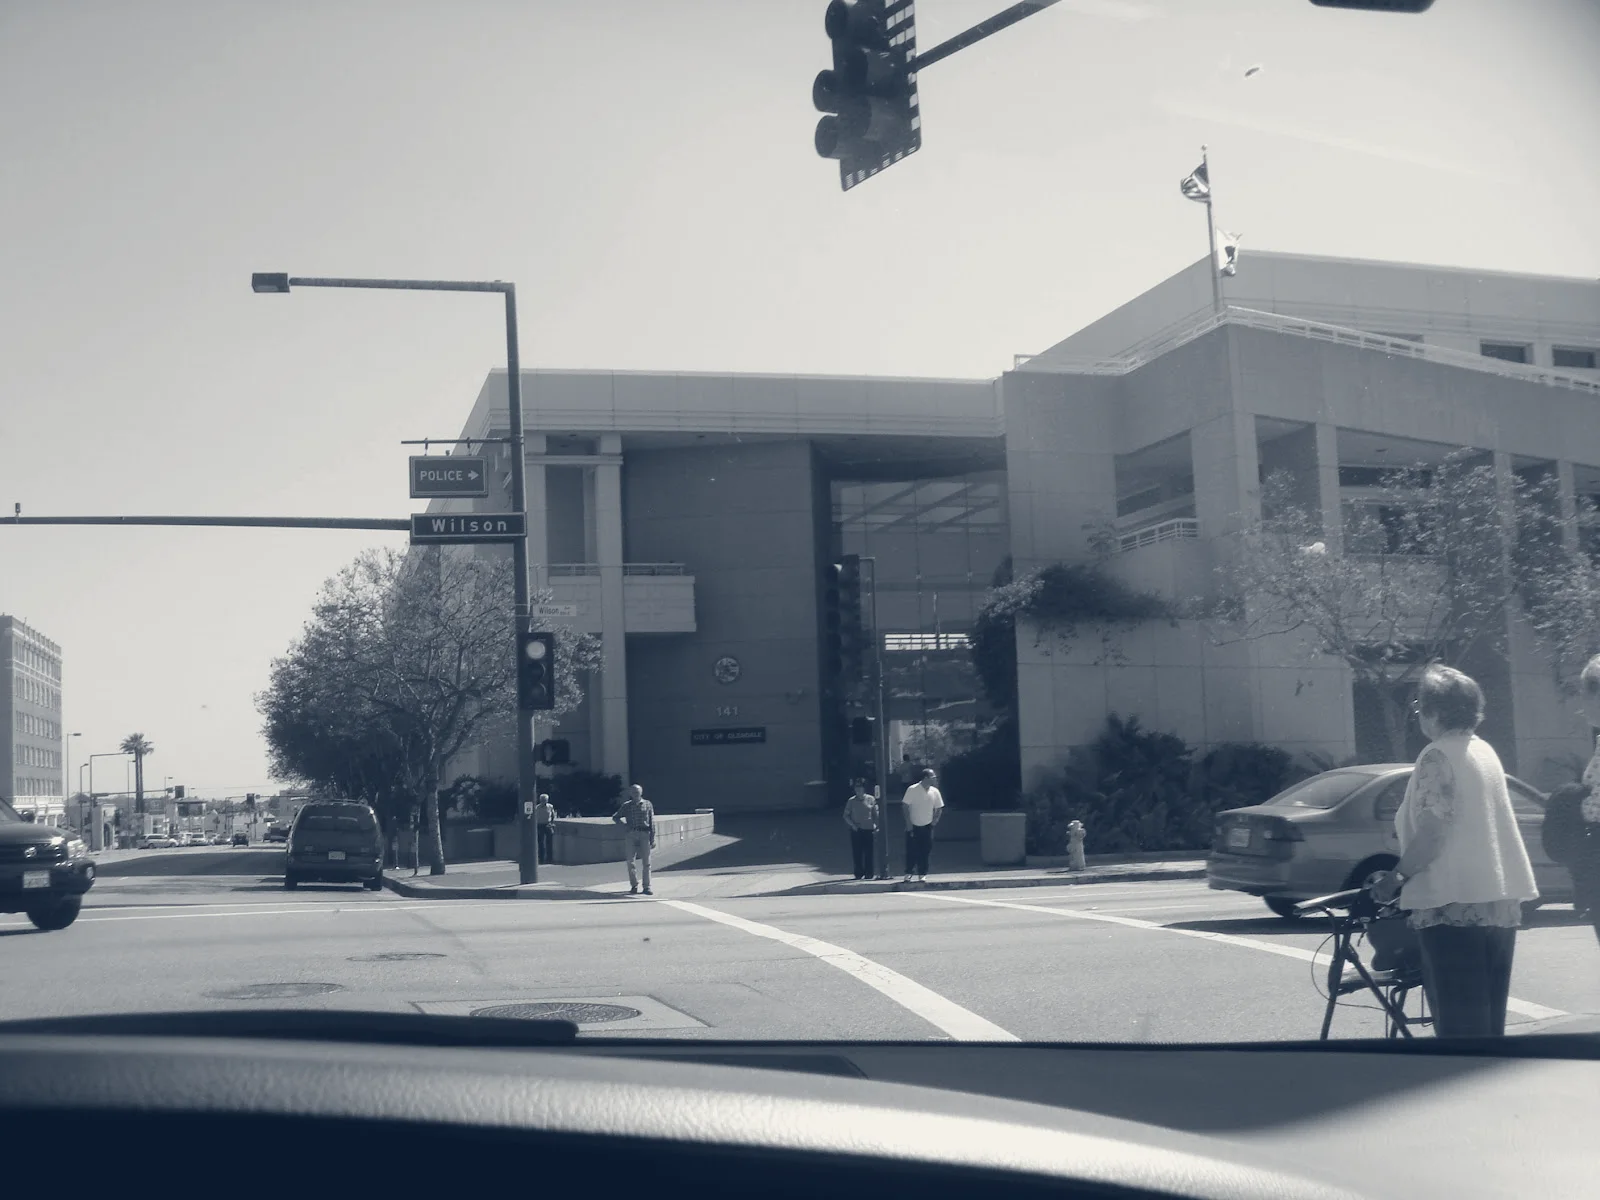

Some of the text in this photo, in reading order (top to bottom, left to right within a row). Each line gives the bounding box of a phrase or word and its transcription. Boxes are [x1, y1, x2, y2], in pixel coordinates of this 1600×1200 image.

[420, 470, 463, 481] POLICE
[431, 519, 507, 532] Wilson
[539, 606, 560, 615] Wilson
[716, 706, 738, 716] 141
